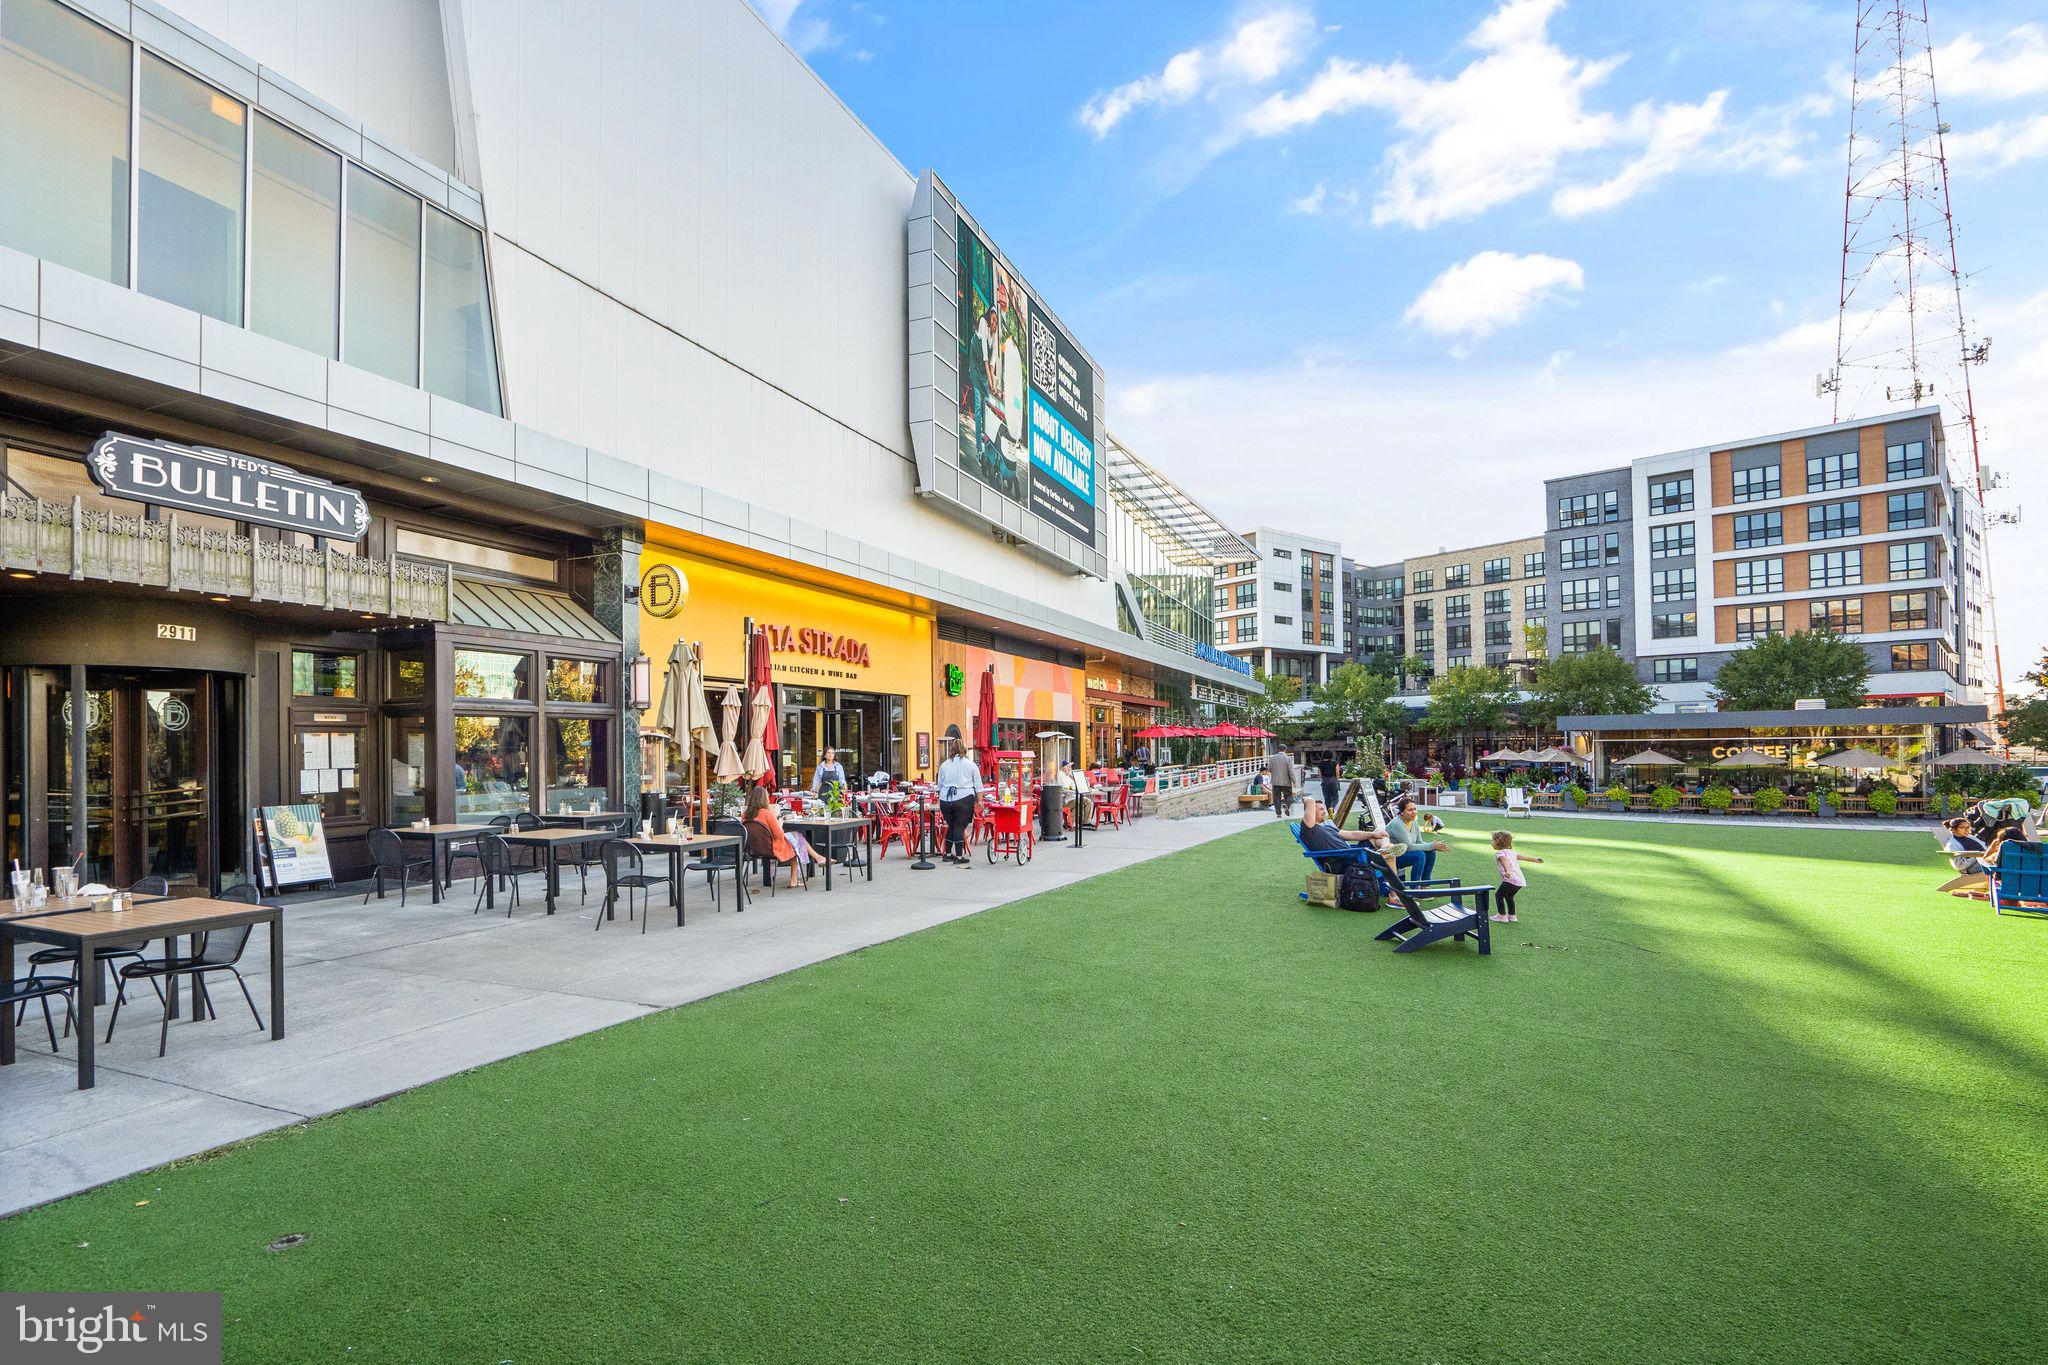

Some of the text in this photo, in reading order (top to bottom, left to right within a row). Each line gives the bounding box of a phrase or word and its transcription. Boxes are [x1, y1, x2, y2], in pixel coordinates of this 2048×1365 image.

[1058, 354, 1077, 381] ORDER
[1059, 369, 1080, 400] NOW ON
[1059, 385, 1088, 421] UBER EATS
[1033, 400, 1091, 470] ROBOT DELIVERY
[229, 456, 269, 476] TED'S
[1033, 431, 1090, 496] NOW AVAILABLE
[130, 452, 346, 527] BULLETIN
[649, 573, 675, 607] B
[159, 625, 194, 640] 2911
[756, 624, 871, 668] LTA STRADA
[789, 665, 819, 675] KITCHEN
[827, 670, 843, 678] WINE
[846, 671, 858, 680] BAR
